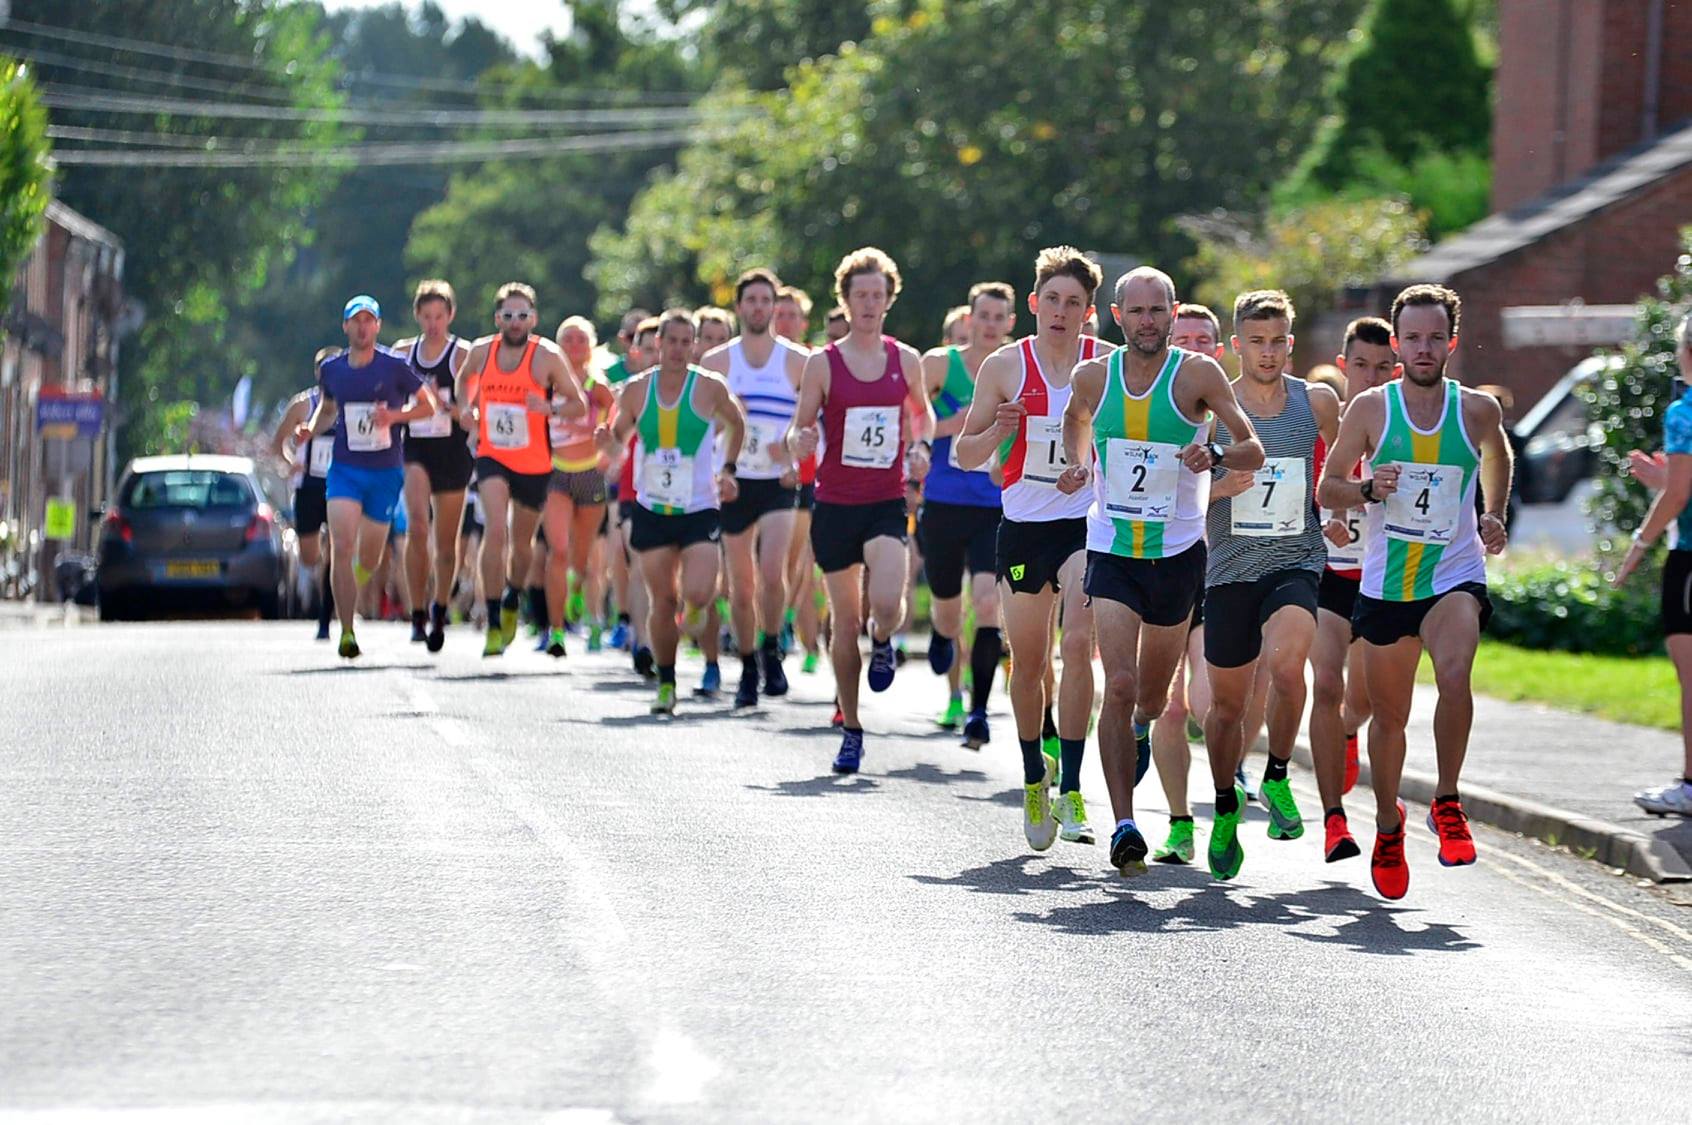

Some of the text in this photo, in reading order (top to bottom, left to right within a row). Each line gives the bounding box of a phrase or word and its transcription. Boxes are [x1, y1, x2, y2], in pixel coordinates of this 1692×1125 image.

[860, 426, 885, 448] 45
[661, 471, 672, 488] 3
[1131, 464, 1147, 493] 2
[1262, 481, 1277, 508] 7
[1414, 488, 1430, 515] 4
